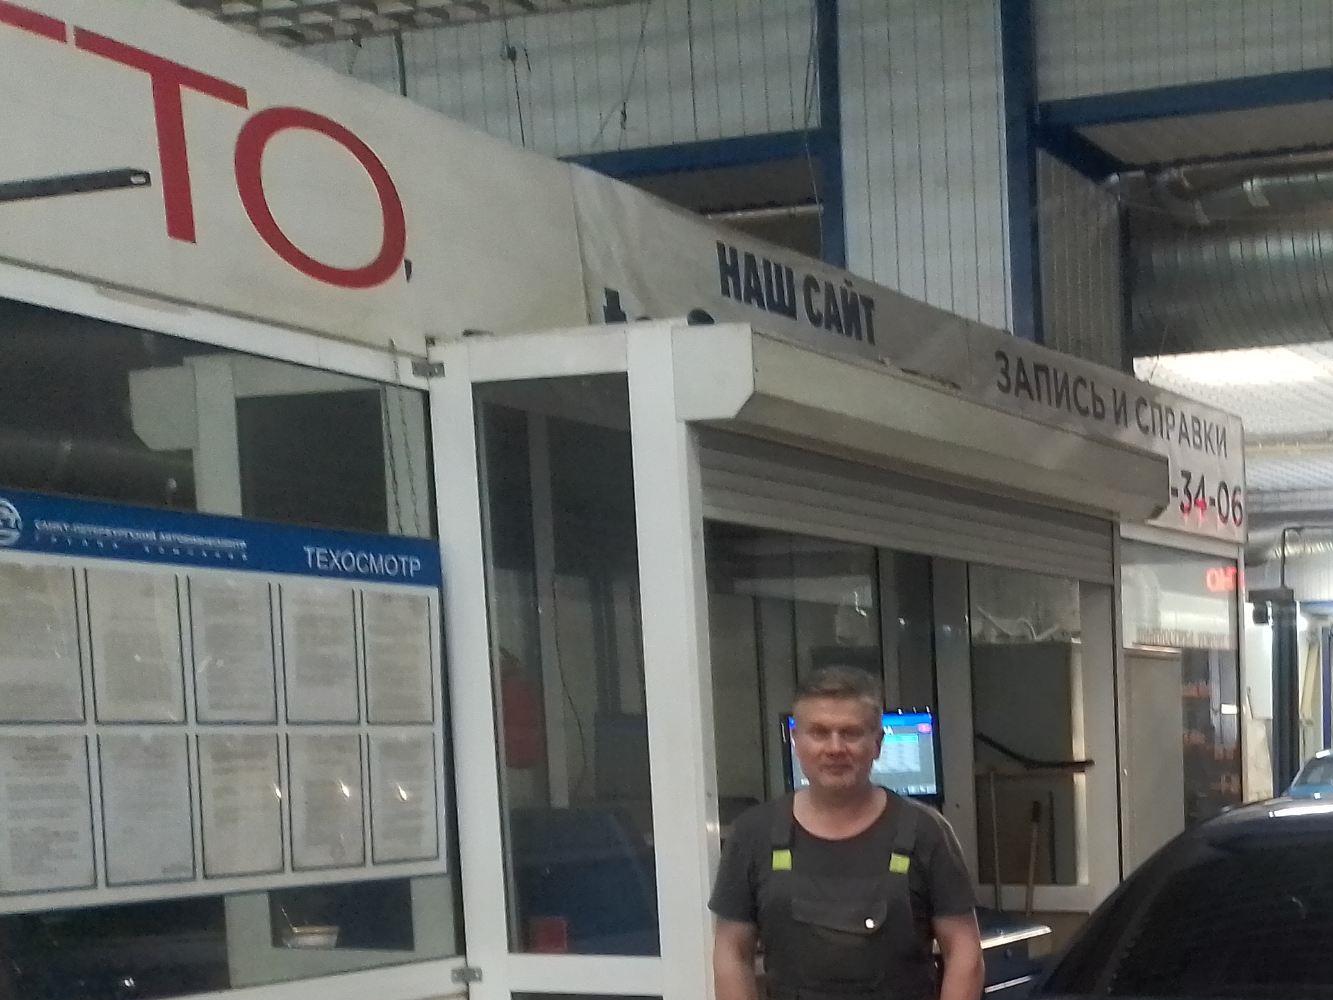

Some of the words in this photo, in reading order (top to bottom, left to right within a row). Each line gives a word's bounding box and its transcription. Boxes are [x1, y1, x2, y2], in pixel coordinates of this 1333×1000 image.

[0, 3, 406, 289] ТО
[715, 239, 798, 321] НАШ
[802, 273, 876, 346] САЙТ
[994, 350, 1106, 421] ЗАПИСЬ
[1112, 387, 1128, 429] И
[1134, 395, 1228, 458] СПРАВКИ
[303, 545, 422, 579] ТЕХОСМОТР
